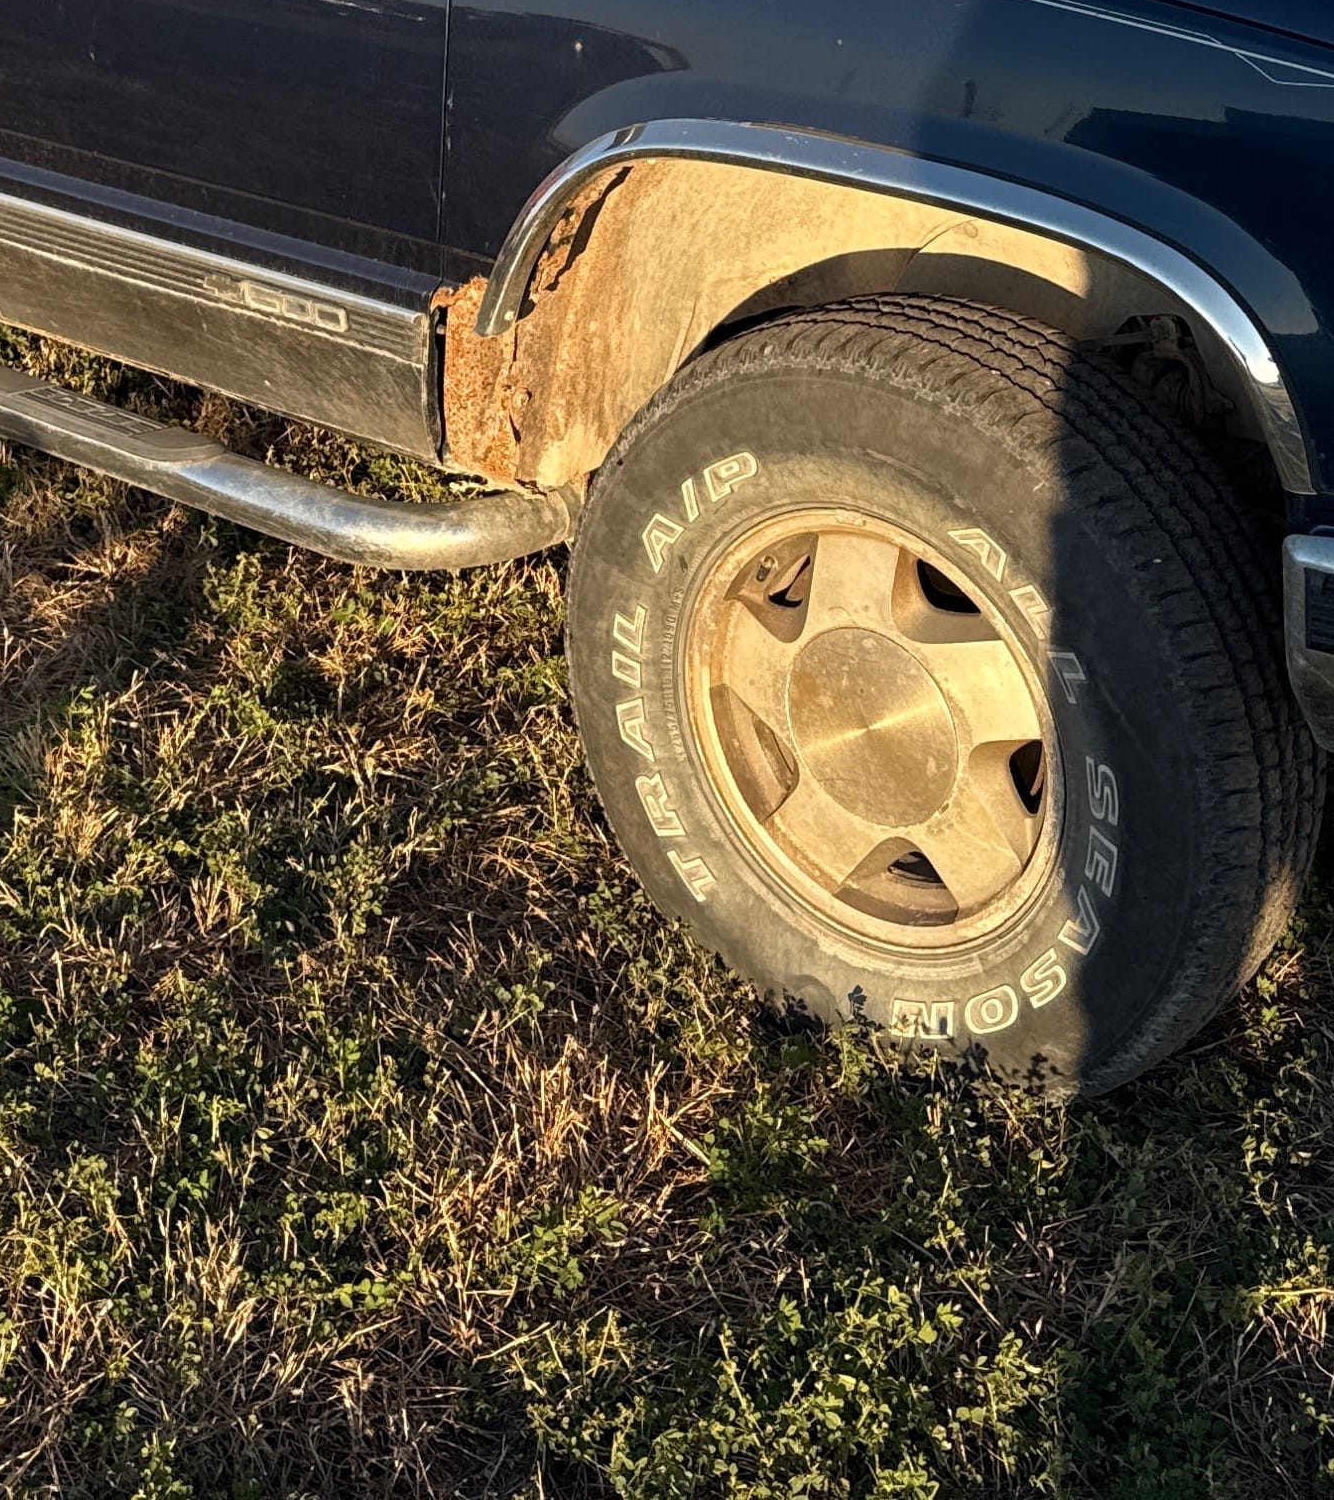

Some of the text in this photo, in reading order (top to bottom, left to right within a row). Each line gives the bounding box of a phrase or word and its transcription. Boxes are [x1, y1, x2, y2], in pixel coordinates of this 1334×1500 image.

[612, 451, 759, 902] TRAIL A/P
[891, 527, 1119, 1039] ALL SEASON
